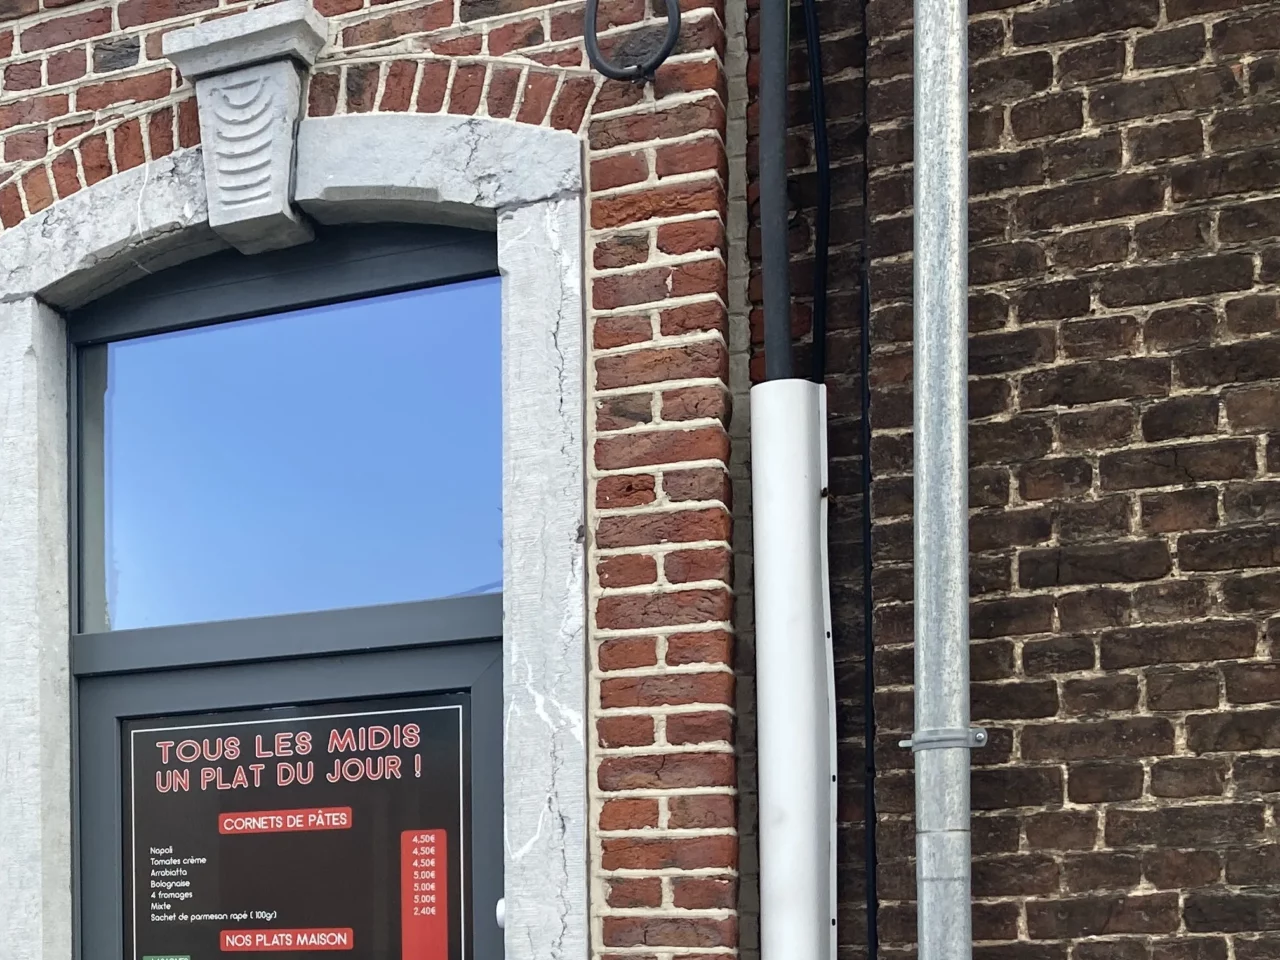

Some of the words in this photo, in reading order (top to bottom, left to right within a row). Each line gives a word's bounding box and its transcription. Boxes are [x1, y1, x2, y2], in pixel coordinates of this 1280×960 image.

[156, 737, 240, 764] TOUS
[256, 731, 312, 758] LES
[328, 723, 421, 753] MIDIS
[156, 769, 189, 793] UN
[201, 764, 265, 790] PLAT
[277, 761, 314, 786] DU
[326, 757, 401, 783] JOUR
[223, 815, 283, 831] CORNETS
[287, 815, 304, 827] DE
[308, 810, 347, 826] PÂTES
[150, 846, 173, 856] Napoli
[150, 857, 180, 866] Tomates
[183, 856, 206, 864] crème
[151, 868, 187, 877] Arrabiatta
[151, 880, 190, 889] Bolognaise
[158, 891, 192, 900] fromages
[151, 902, 171, 910] Mixte
[151, 913, 176, 921] Sachet
[190, 912, 228, 922] parmesan
[230, 910, 248, 921] rapé
[225, 934, 252, 946] NOS
[256, 933, 292, 946] PLATS
[296, 932, 347, 946] MAISON
